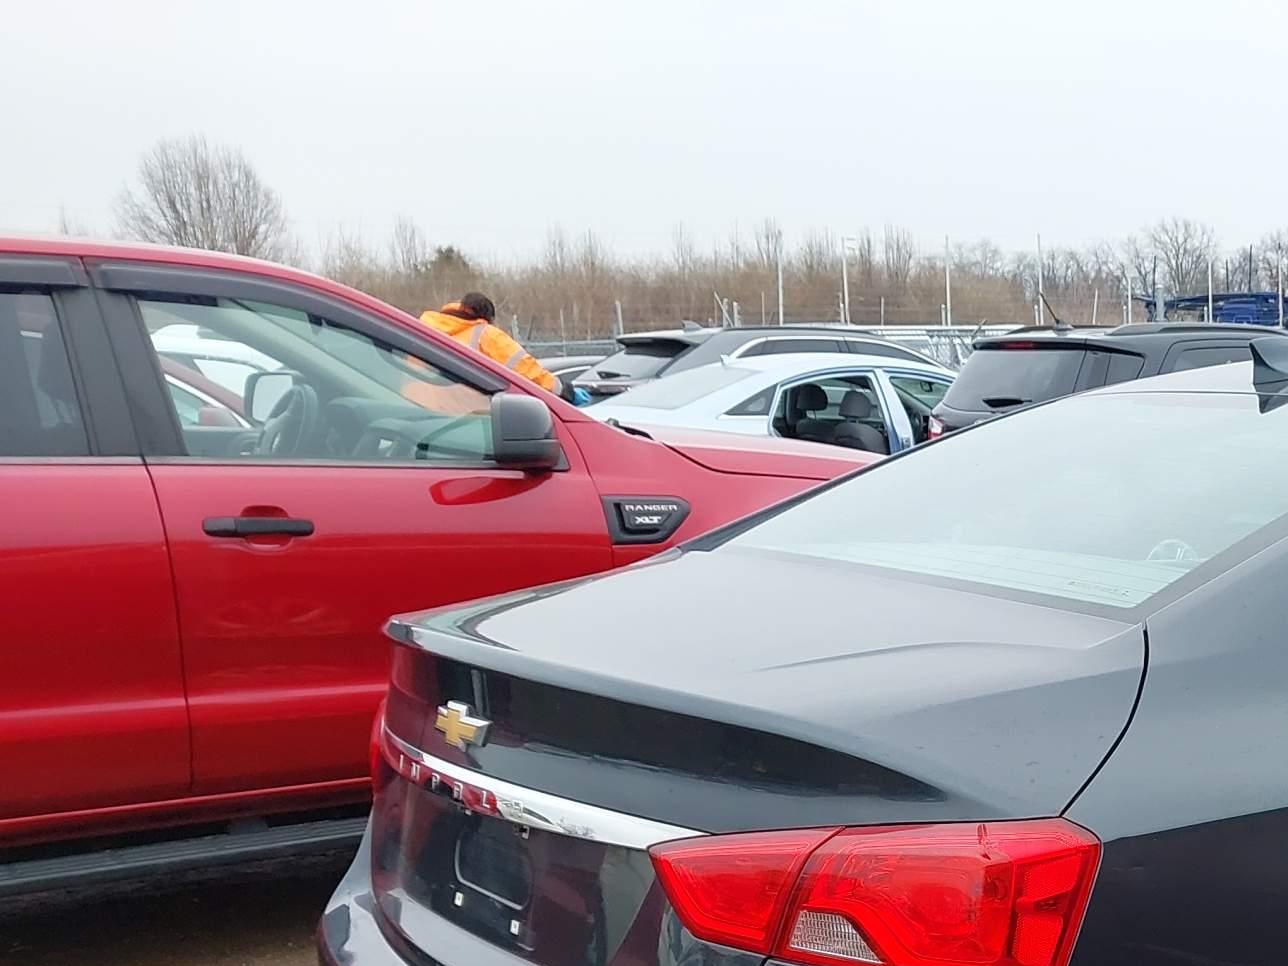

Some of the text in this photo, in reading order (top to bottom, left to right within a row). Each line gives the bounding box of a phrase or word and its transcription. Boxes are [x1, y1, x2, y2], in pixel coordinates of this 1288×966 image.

[624, 504, 678, 512] RANGER
[635, 516, 662, 524] XLT
[399, 754, 523, 817] IMPALA
